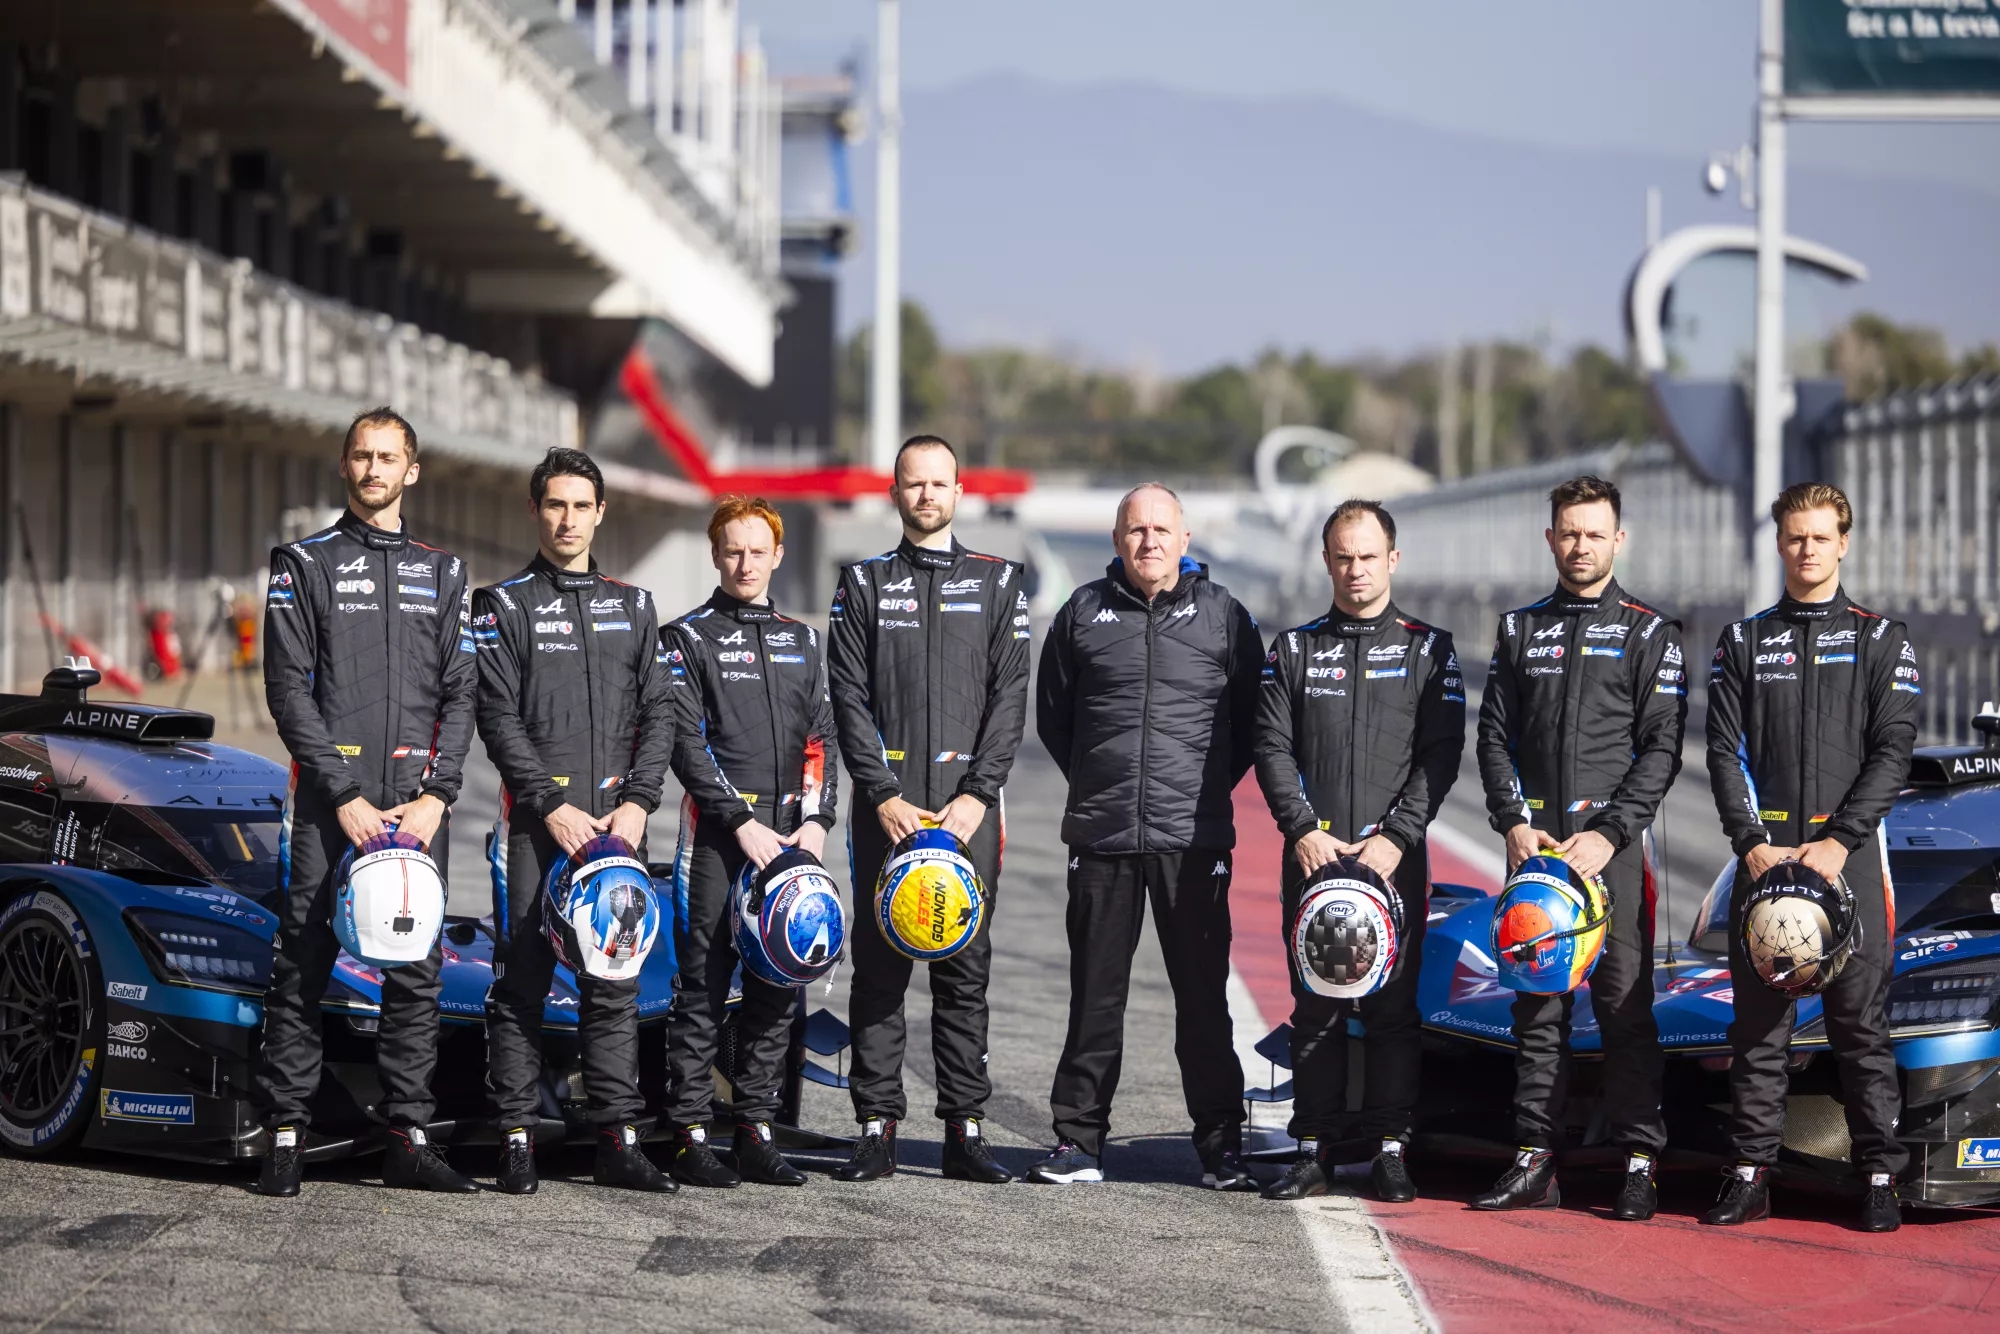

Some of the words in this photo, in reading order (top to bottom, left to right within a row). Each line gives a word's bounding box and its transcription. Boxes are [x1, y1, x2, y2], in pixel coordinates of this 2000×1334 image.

[398, 562, 432, 573] WEC
[942, 579, 982, 588] WEC
[999, 564, 1014, 588] Sabelt
[590, 599, 623, 608] WEC
[880, 598, 903, 610] elf
[536, 621, 560, 634] elf
[1506, 614, 1516, 636] Sabelt
[1587, 624, 1630, 635] WEC
[1642, 616, 1662, 640] Sabelt
[1872, 618, 1890, 640] Sabelt
[766, 632, 794, 642] WEC
[1732, 624, 1744, 642] Sabelt
[1817, 630, 1857, 640] WEC
[1288, 632, 1298, 654] Sabelt
[1368, 645, 1408, 655] WEC
[1420, 632, 1438, 656] Sabelt
[719, 652, 742, 662] elf
[1527, 648, 1550, 658] elf
[1666, 642, 1682, 660] 24h
[1757, 652, 1781, 664] elf
[1307, 667, 1332, 678] elf
[1658, 668, 1676, 682] elf
[1895, 666, 1912, 678] elf
[1444, 677, 1458, 688] elf
[63, 711, 140, 730] ALPINE
[0, 763, 42, 780] essolver
[1954, 758, 2000, 774] ALPIN
[1761, 812, 1784, 820] Sabelt
[904, 851, 960, 862] ALPINE
[1314, 880, 1372, 892] ALPINE
[1752, 885, 1822, 900] ALPINE
[175, 888, 237, 906] ixell
[776, 882, 798, 912] ORLINSKI
[882, 870, 903, 926] ALPINE
[918, 879, 931, 927] JULES
[52, 902, 70, 920] SPORT
[208, 903, 244, 918] elf
[932, 881, 948, 942] GOUNON
[620, 934, 632, 944] 19
[1298, 904, 1314, 976] ALPINE
[1369, 908, 1386, 980] ALPINE
[1908, 931, 1973, 948] ixell
[1900, 946, 1935, 960] elf
[110, 984, 142, 999] Sabelt
[108, 1044, 147, 1060] BAHCO
[37, 1080, 84, 1142] MICHELIN
[124, 1103, 191, 1116] MICHELIN
